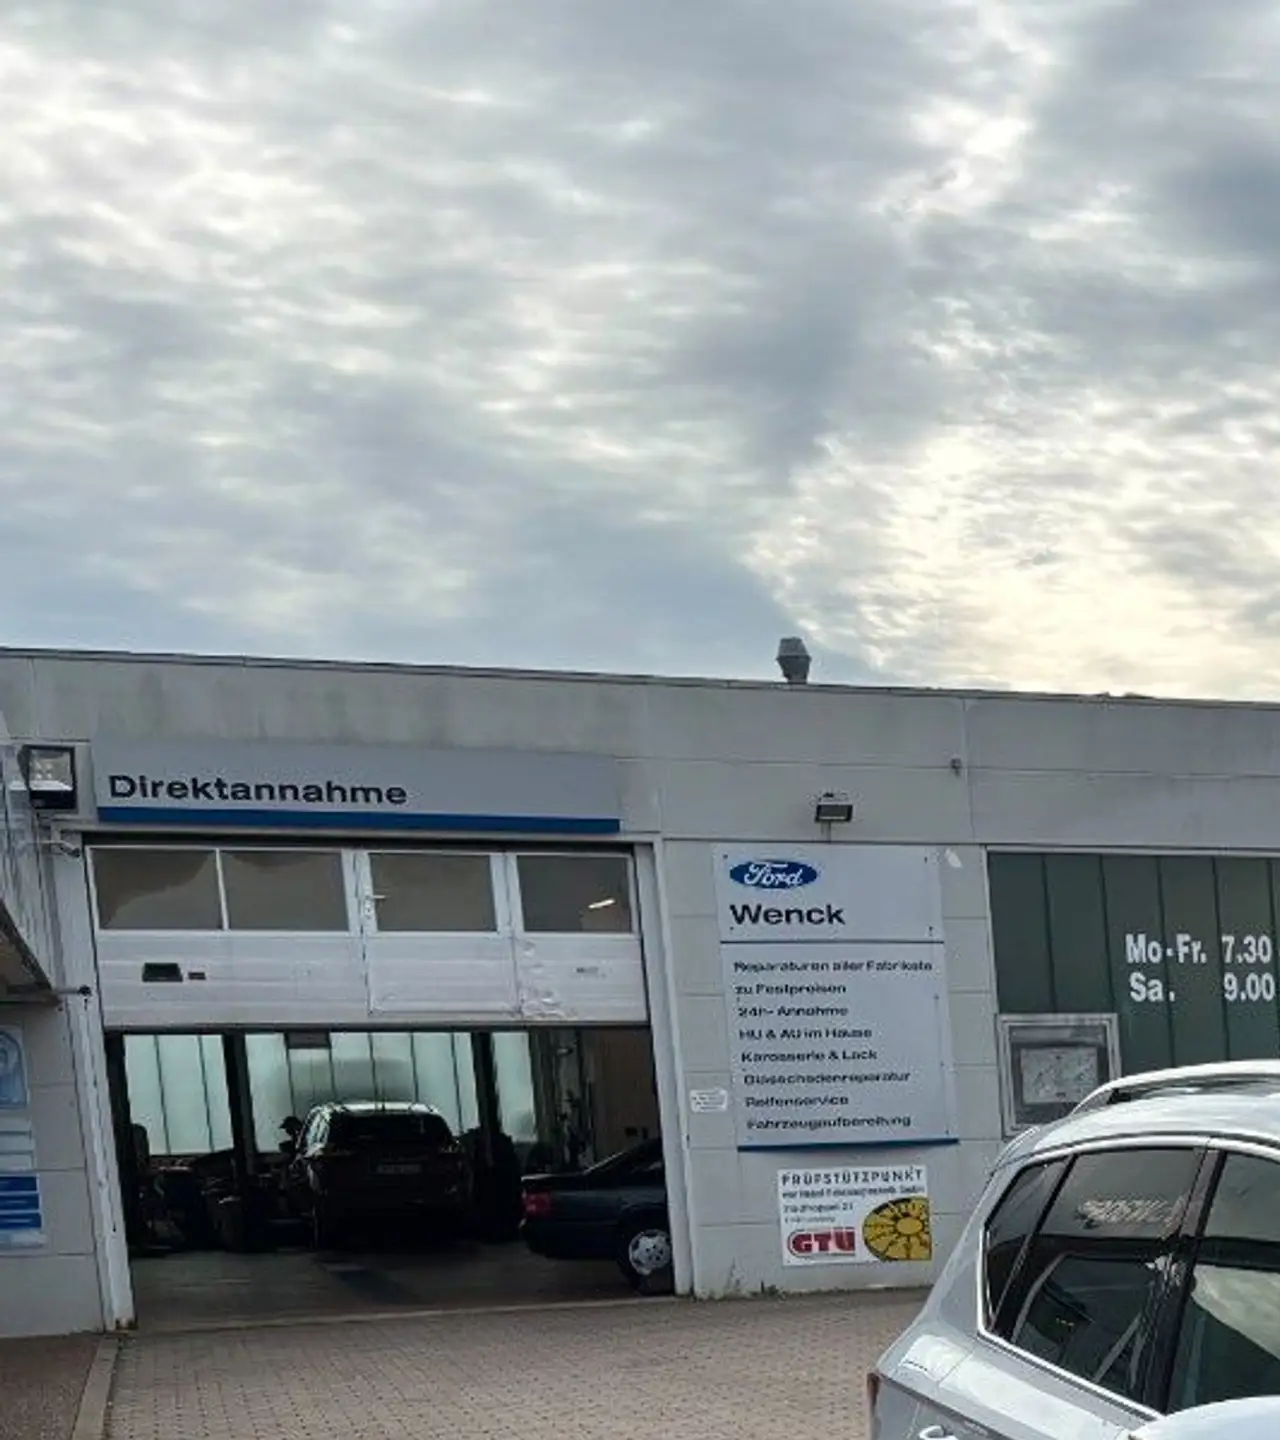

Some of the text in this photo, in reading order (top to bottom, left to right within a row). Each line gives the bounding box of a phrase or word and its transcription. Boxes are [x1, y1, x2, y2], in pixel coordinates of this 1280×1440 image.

[108, 774, 408, 805] Direktannahme
[743, 860, 804, 887] Ford
[729, 903, 846, 925] Wenck
[1221, 935, 1273, 963] 7.30
[733, 959, 830, 973] Reparaturen
[832, 959, 864, 972] aller
[734, 985, 753, 995] zu
[1129, 972, 1176, 1002] Sa.
[1223, 972, 1276, 1001] 9.00
[825, 1027, 873, 1039] Hause
[741, 1051, 826, 1063] Karosserie
[842, 1049, 878, 1061] Lack
[792, 1227, 856, 1254] GTÜ
